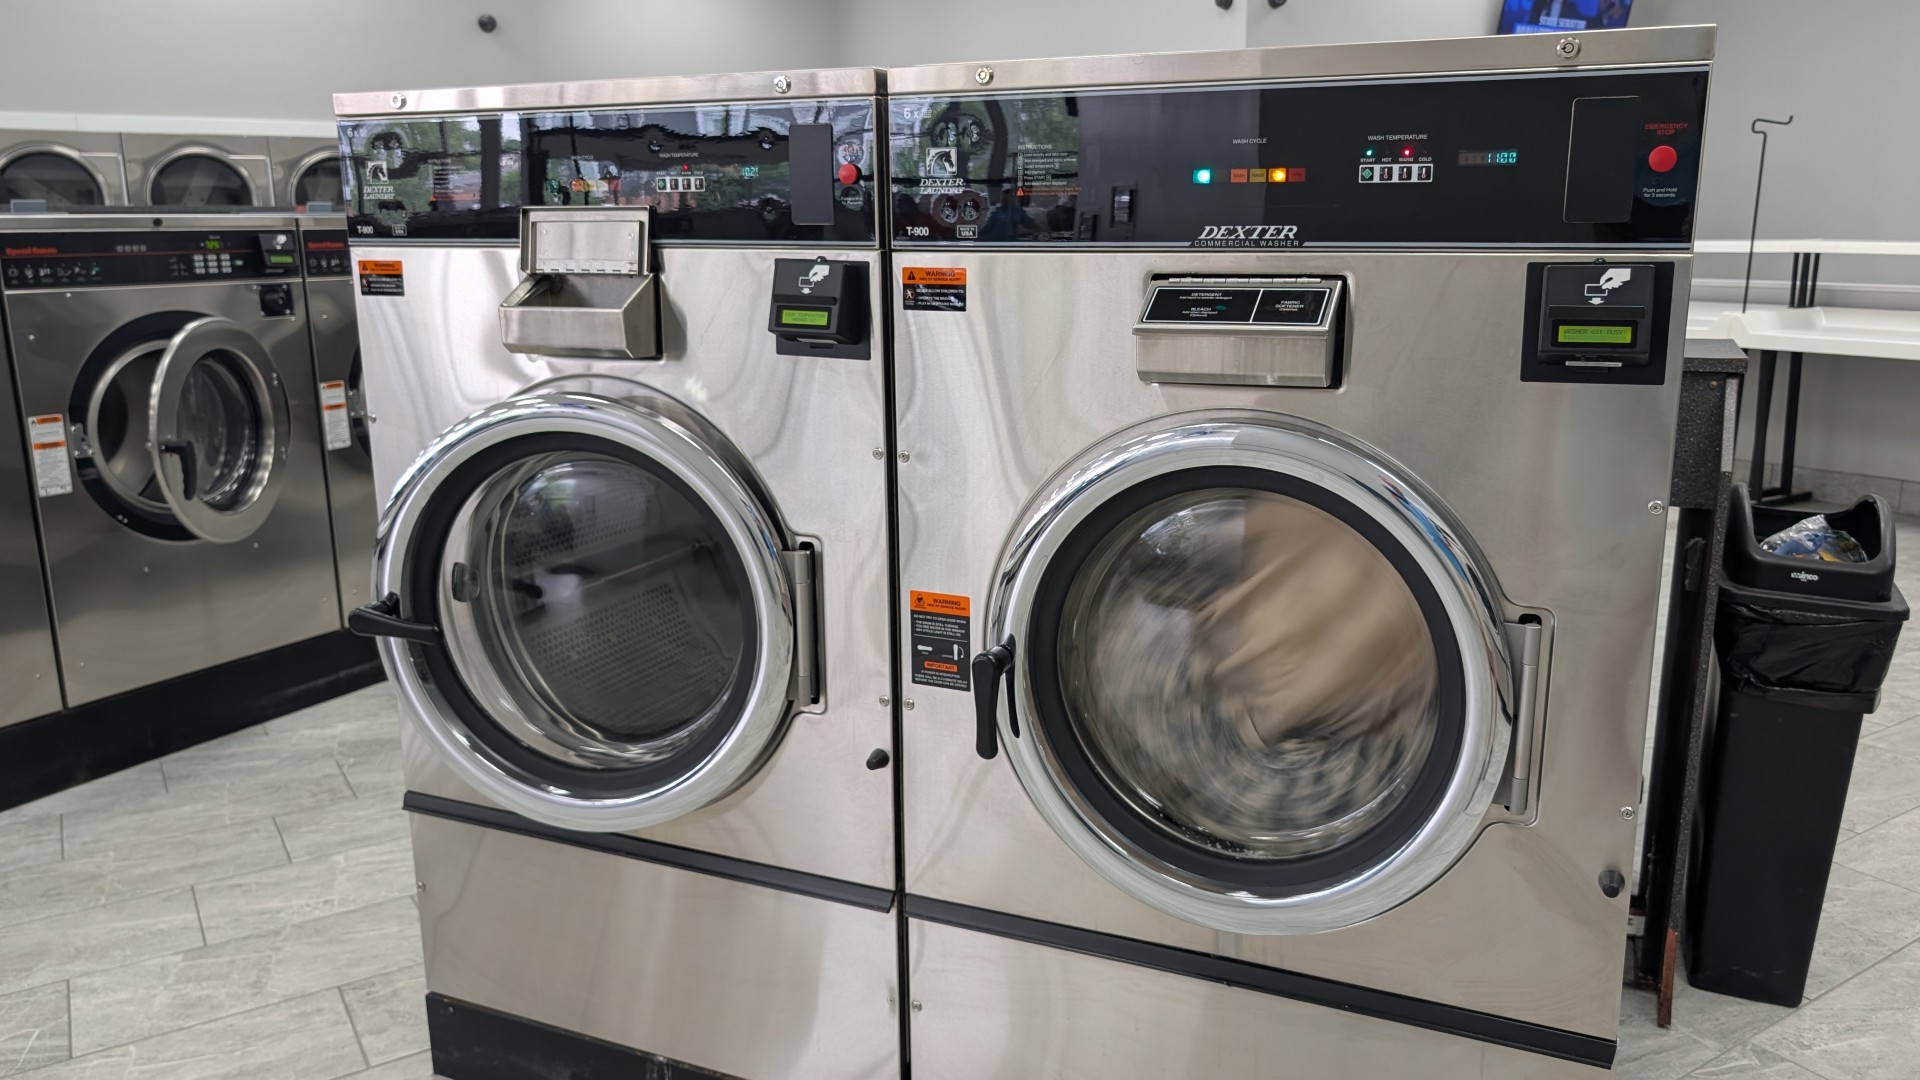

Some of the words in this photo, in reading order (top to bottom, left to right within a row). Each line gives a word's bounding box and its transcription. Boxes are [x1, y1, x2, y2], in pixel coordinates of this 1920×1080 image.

[904, 107, 911, 119] 6
[919, 178, 964, 187] DEXTER
[364, 186, 394, 194] DEXTER
[920, 187, 966, 195] LAUNDRY
[356, 226, 374, 235] T-900
[906, 226, 929, 236] T-900
[1198, 225, 1298, 239] DEXTER
[932, 598, 961, 607] WARNING
[927, 662, 955, 670] IMPORTANT
